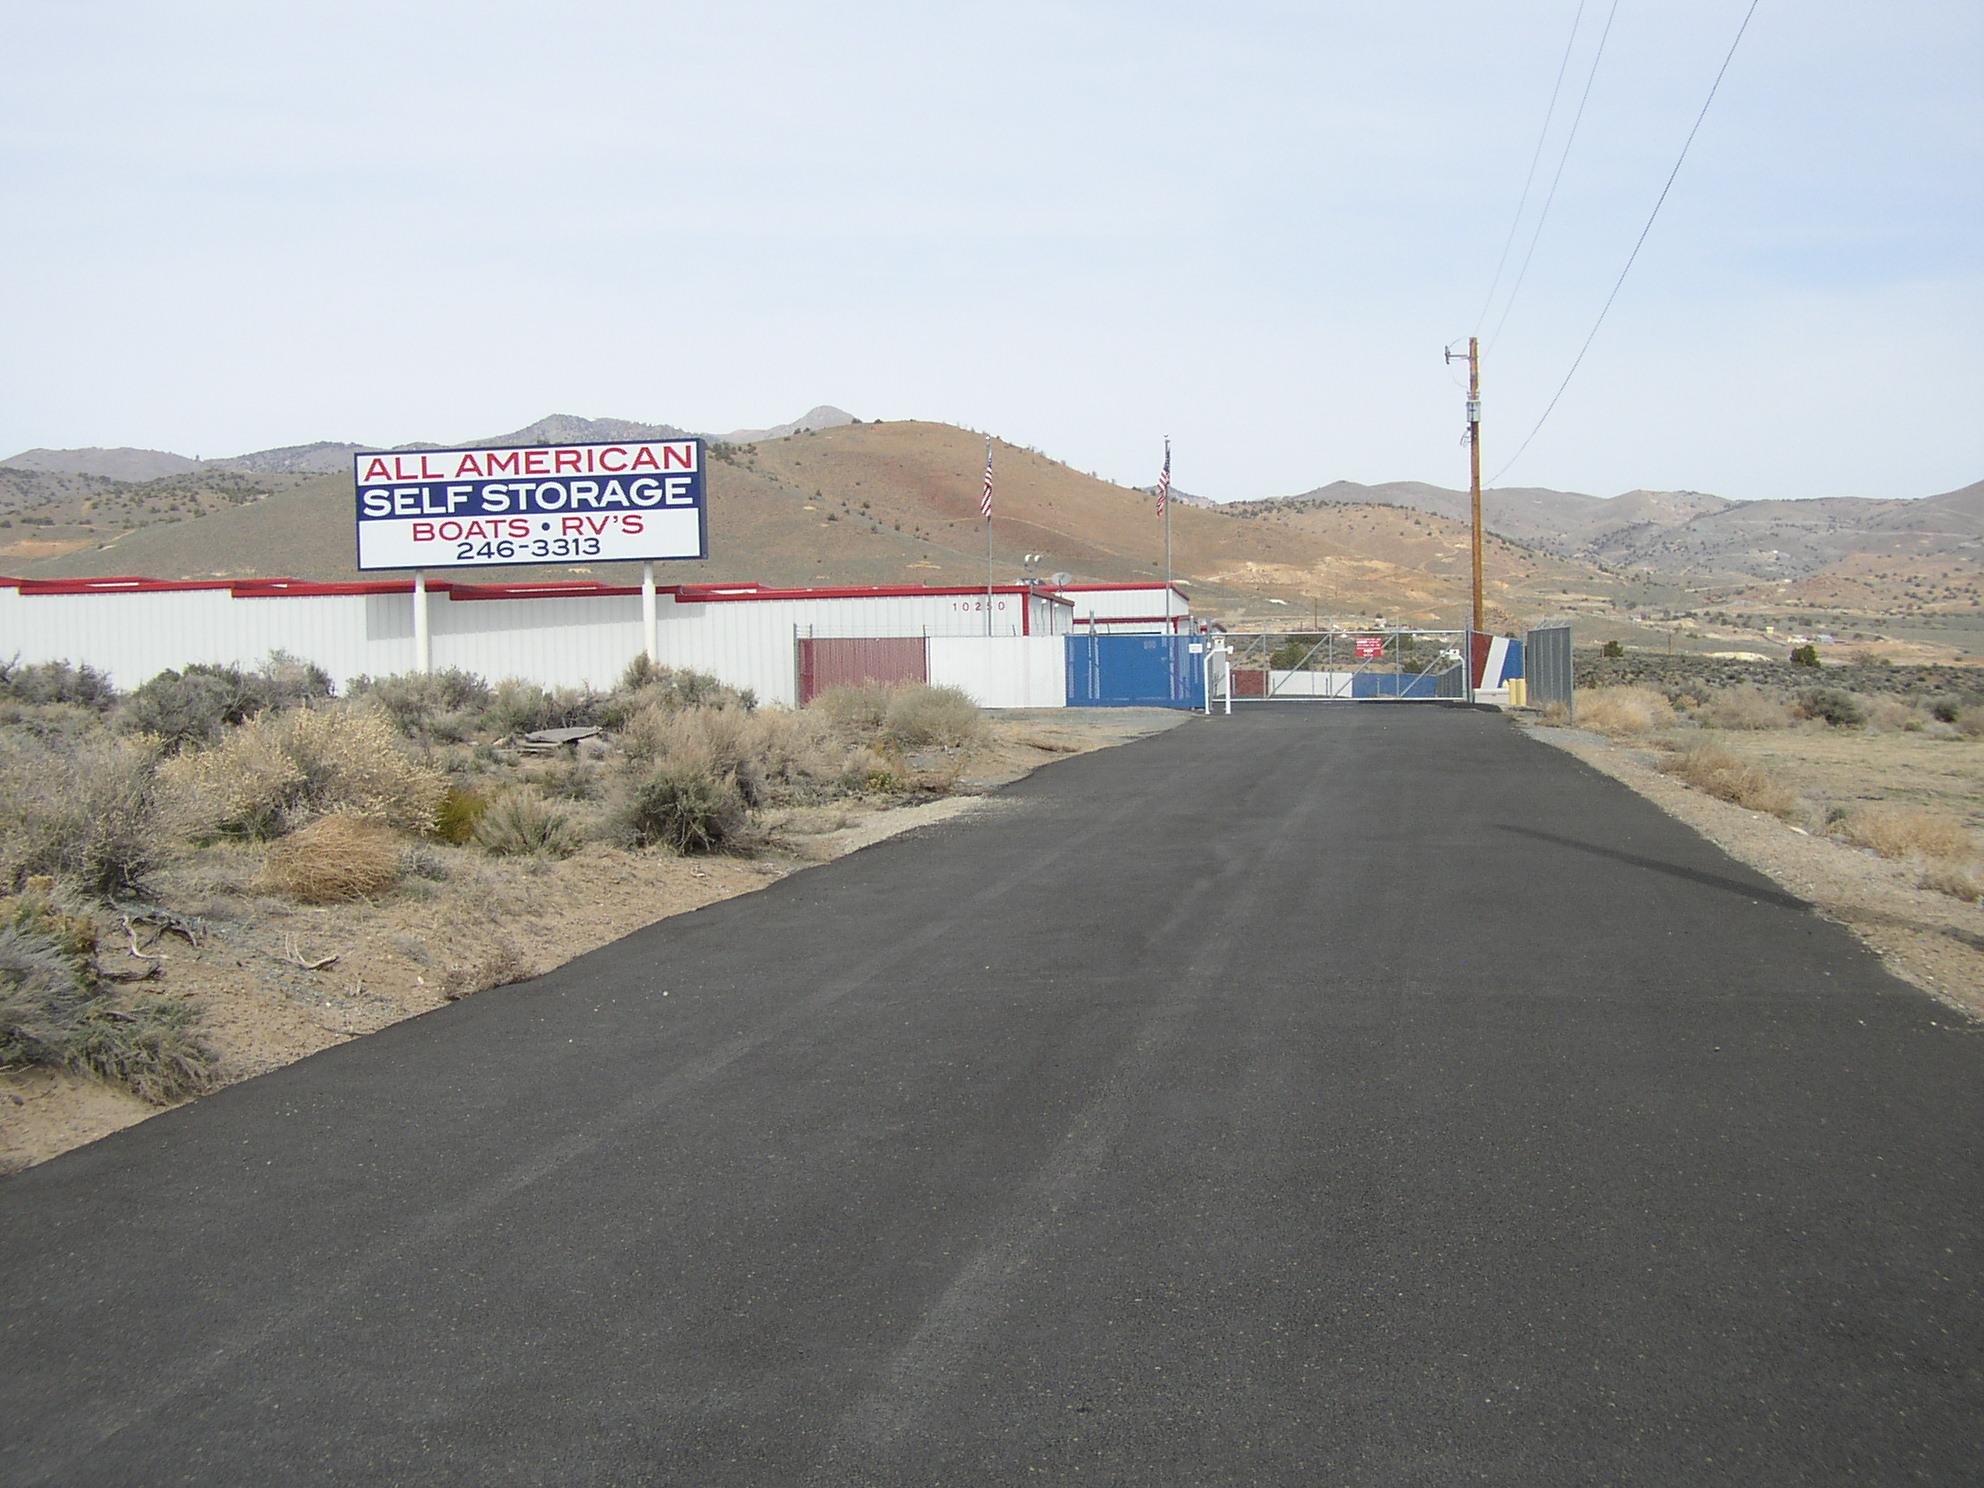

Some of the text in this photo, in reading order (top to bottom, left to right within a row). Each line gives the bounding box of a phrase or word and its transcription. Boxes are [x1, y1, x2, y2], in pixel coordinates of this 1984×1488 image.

[364, 446, 693, 482] ALL AMERICAN
[363, 477, 694, 517] SELF STORAGE
[412, 515, 645, 542] BOATS RV'S
[457, 538, 601, 560] 246-3313
